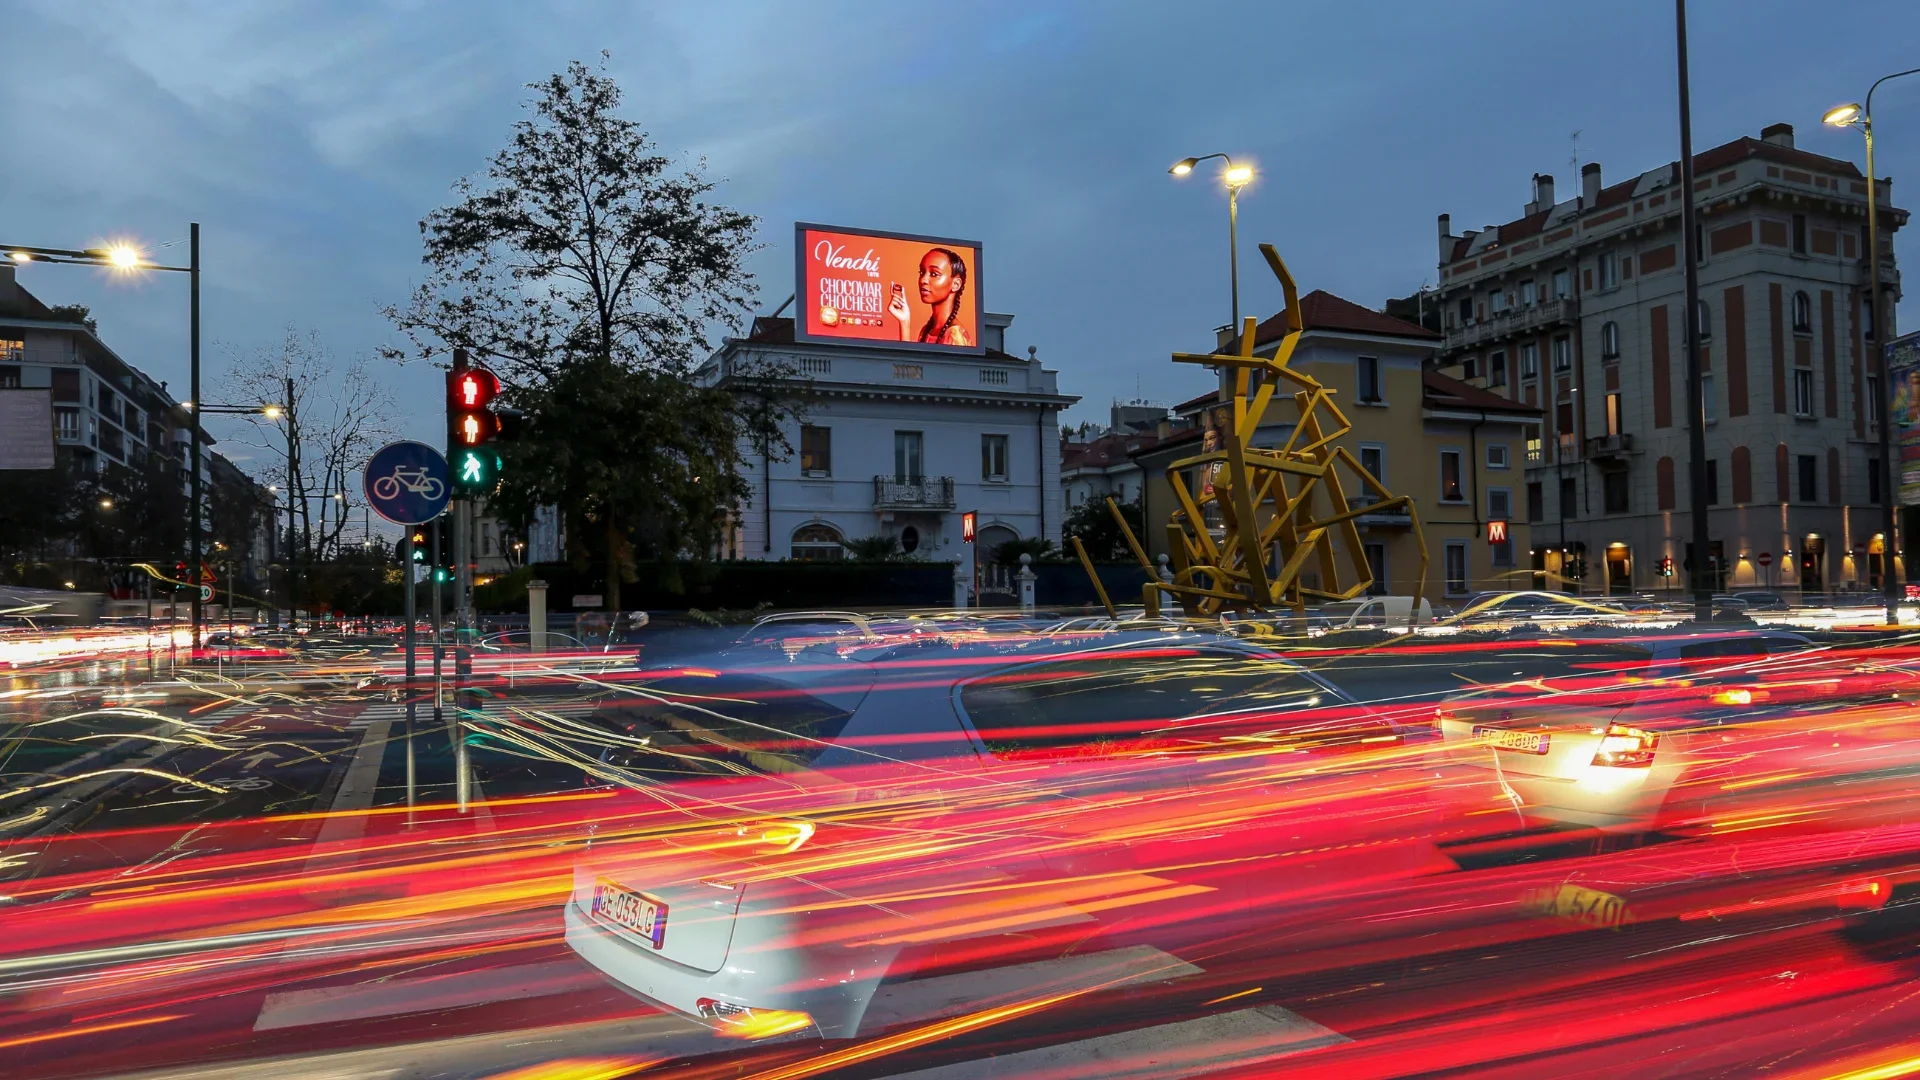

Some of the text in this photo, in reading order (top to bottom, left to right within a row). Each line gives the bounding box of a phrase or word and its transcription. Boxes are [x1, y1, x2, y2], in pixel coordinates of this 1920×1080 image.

[815, 240, 880, 271] Venchi
[820, 277, 882, 298] CHOCOMAR
[820, 293, 882, 313] CHOCHESEI
[963, 518, 974, 537] M
[1489, 525, 1505, 541] M
